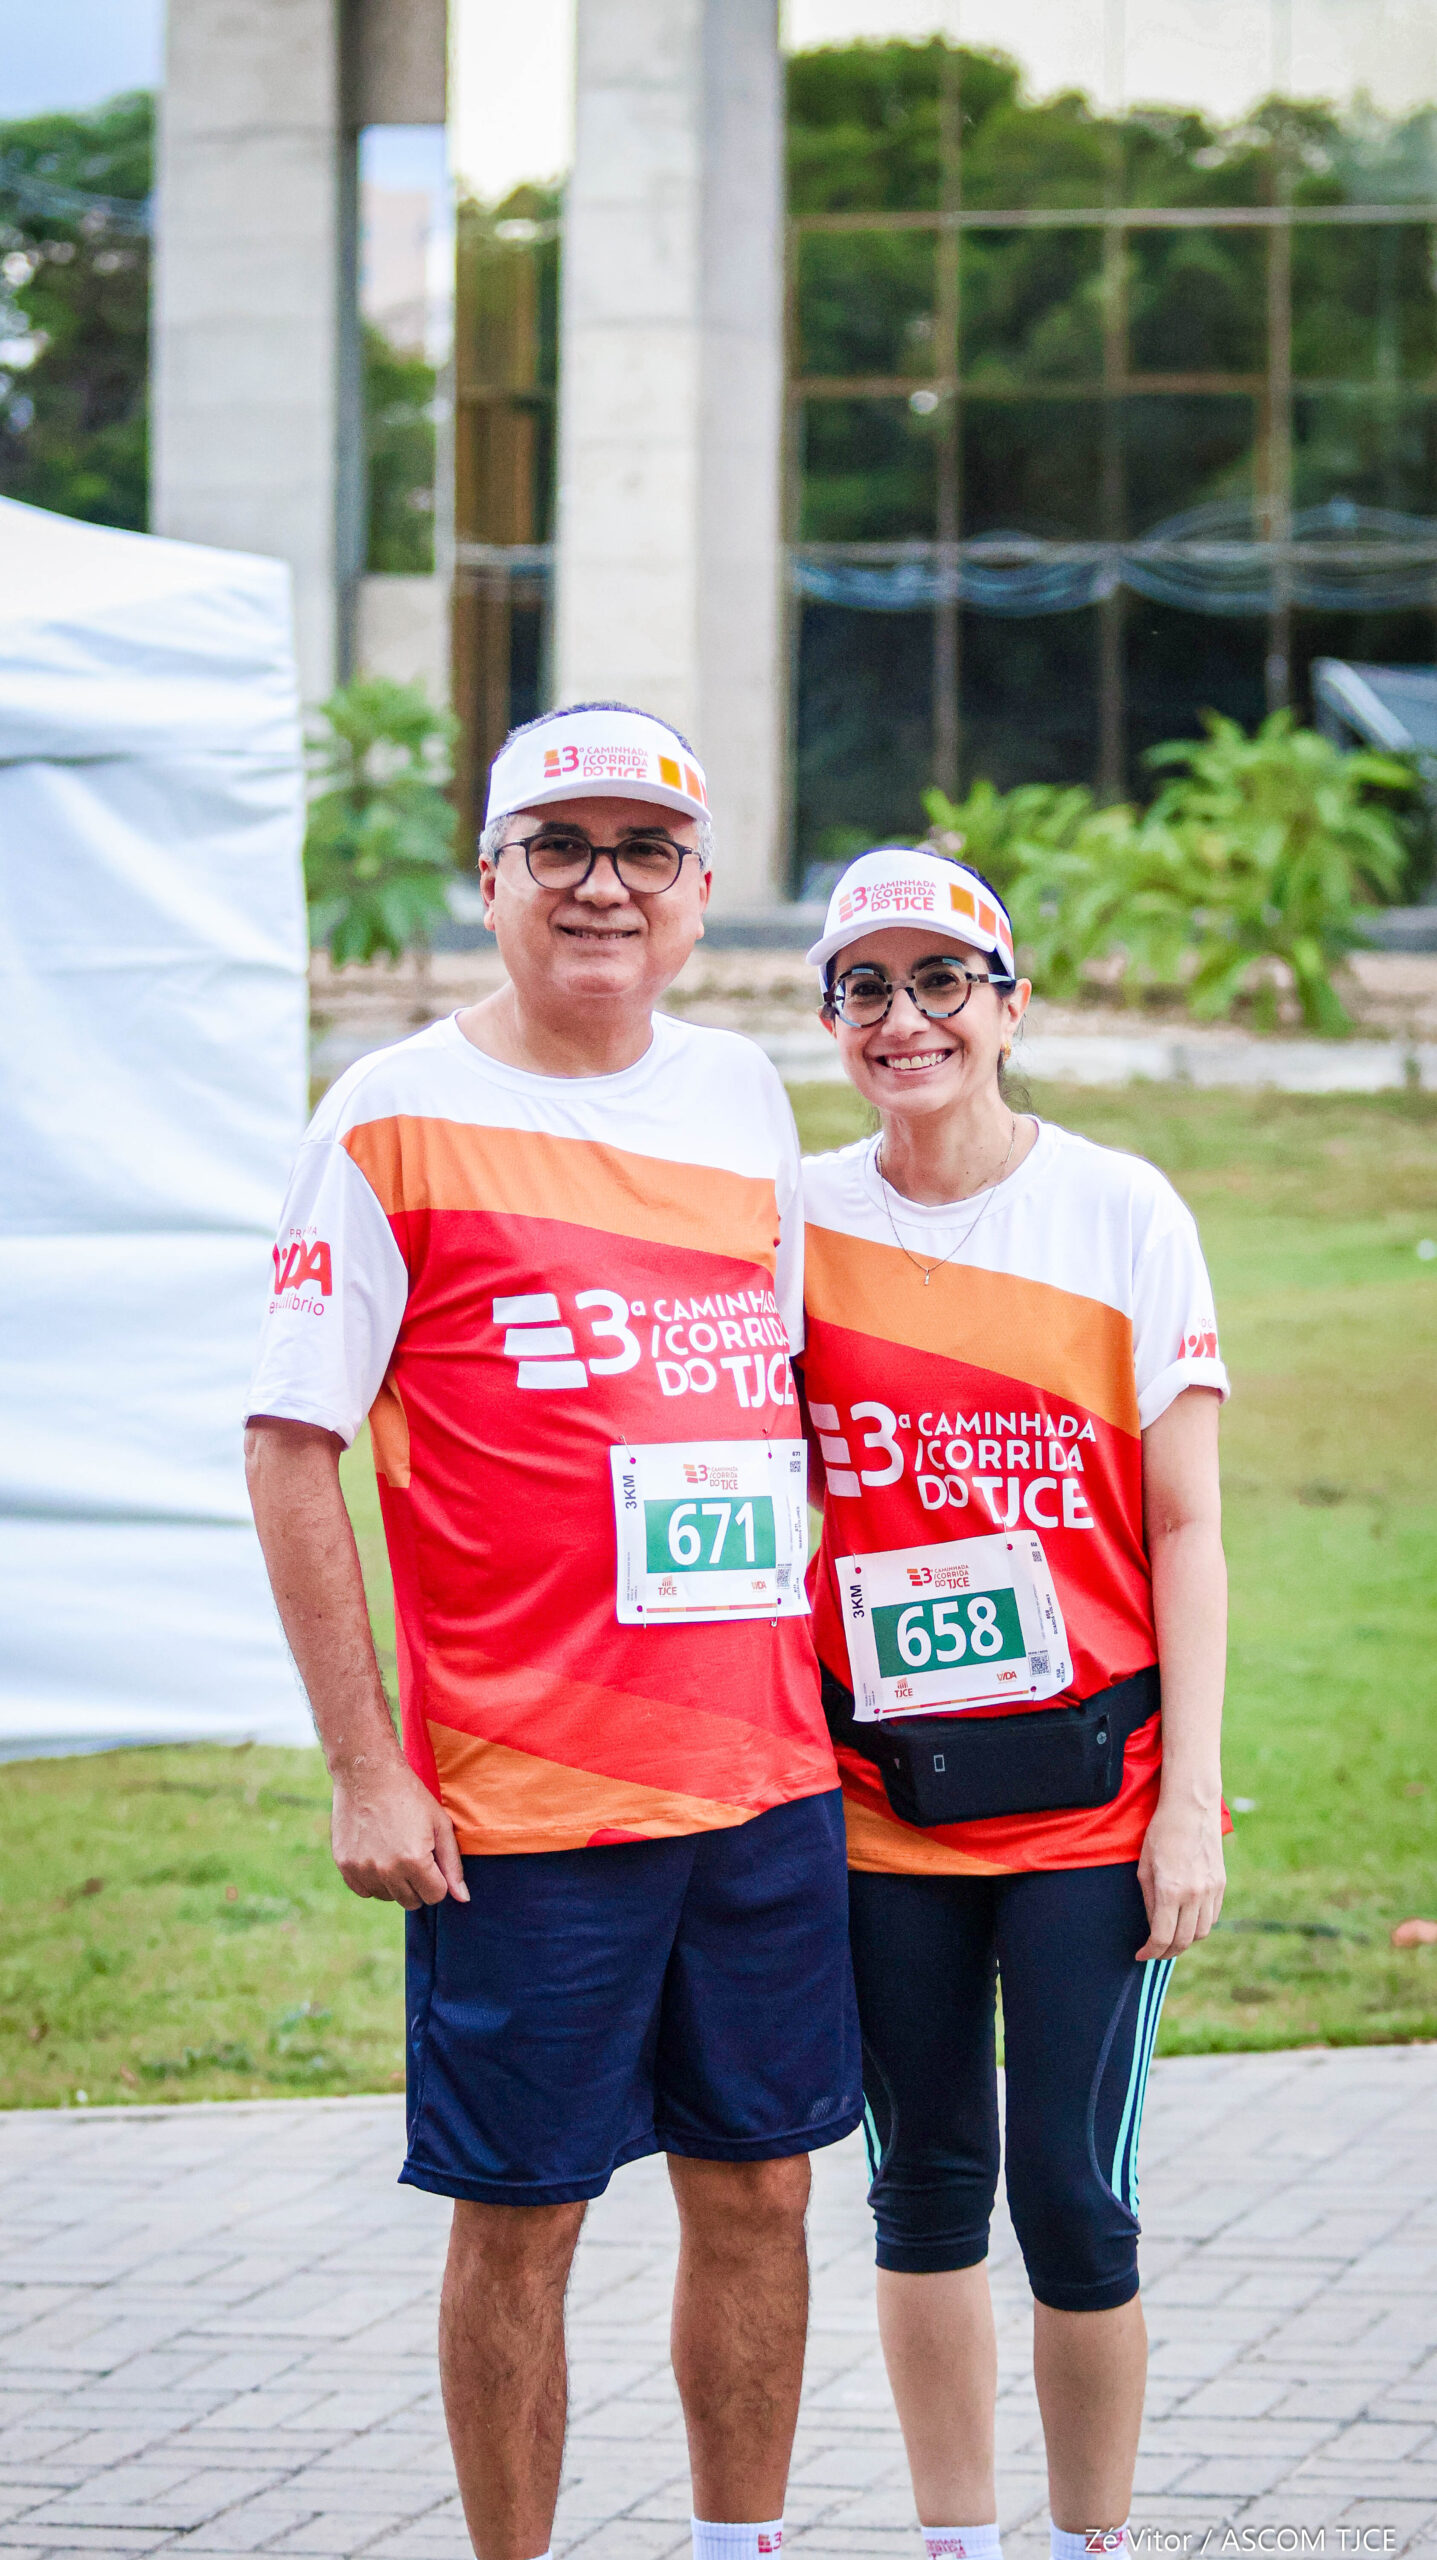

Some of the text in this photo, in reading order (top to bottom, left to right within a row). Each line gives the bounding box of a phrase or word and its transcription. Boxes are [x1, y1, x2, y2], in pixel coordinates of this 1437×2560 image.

[587, 746, 648, 757] CAMINHADA
[583, 766, 604, 778] DO
[873, 880, 937, 892] CAMINHADA
[871, 896, 935, 912] DO TJCE
[655, 1353, 795, 1408] DO TJCE
[918, 1411, 1097, 1442] CAMINHADA
[914, 1439, 1085, 1472] /CORRIDA
[622, 1475, 638, 1509] 3KM
[721, 1479, 739, 1490] TJCE
[917, 1474, 1095, 1529] DO TJCE
[668, 1501, 756, 1566] 671
[658, 1586, 678, 1596] TJCE
[934, 1576, 970, 1589] DO TJCE
[850, 1584, 865, 1619] 3KM
[896, 1596, 1004, 1667] 658
[894, 1688, 914, 1699] TJCE
